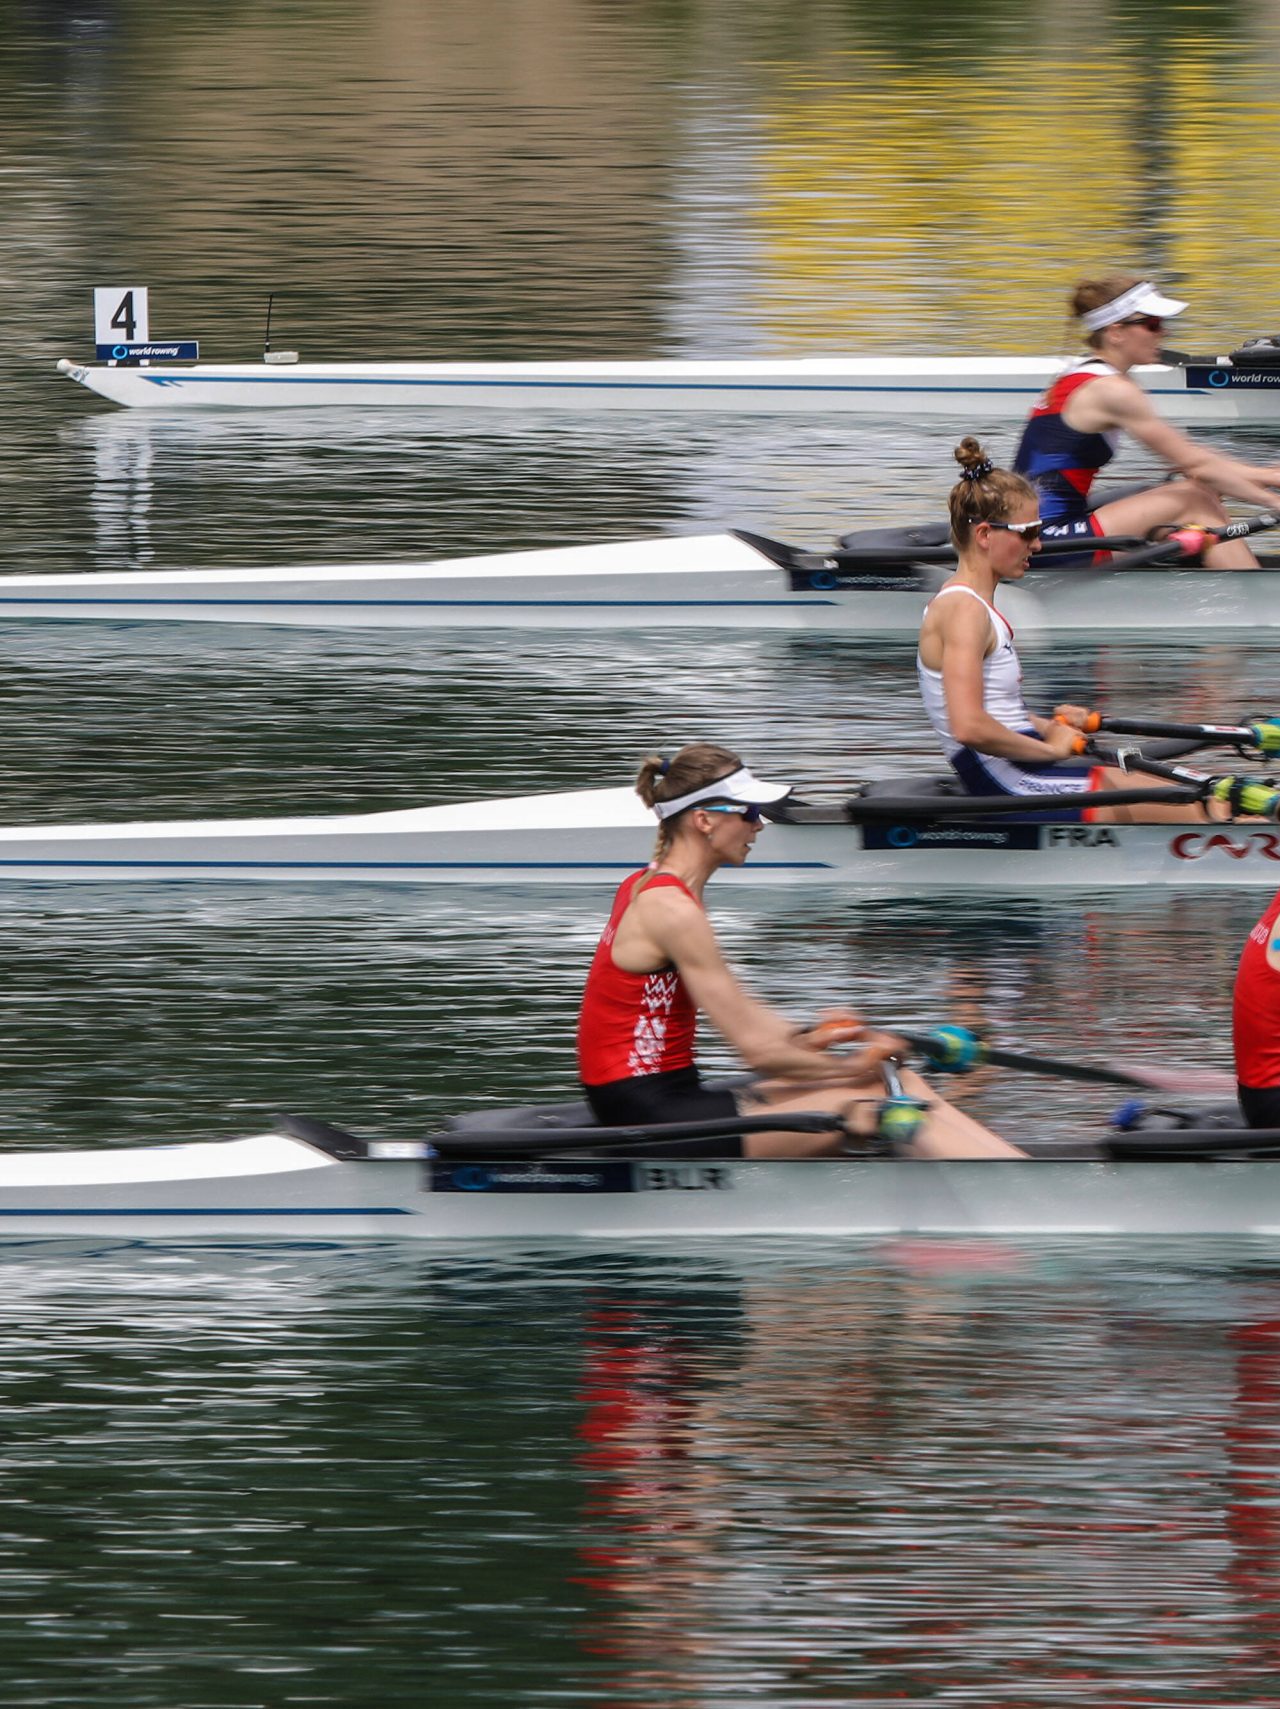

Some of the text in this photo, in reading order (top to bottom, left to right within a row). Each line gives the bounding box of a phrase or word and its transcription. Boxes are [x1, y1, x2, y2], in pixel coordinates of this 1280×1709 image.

[110, 290, 137, 341] 4
[128, 346, 179, 357] world rowing
[1231, 373, 1261, 383] world
[1050, 827, 1121, 848] FRA
[645, 1167, 730, 1191] BLR
